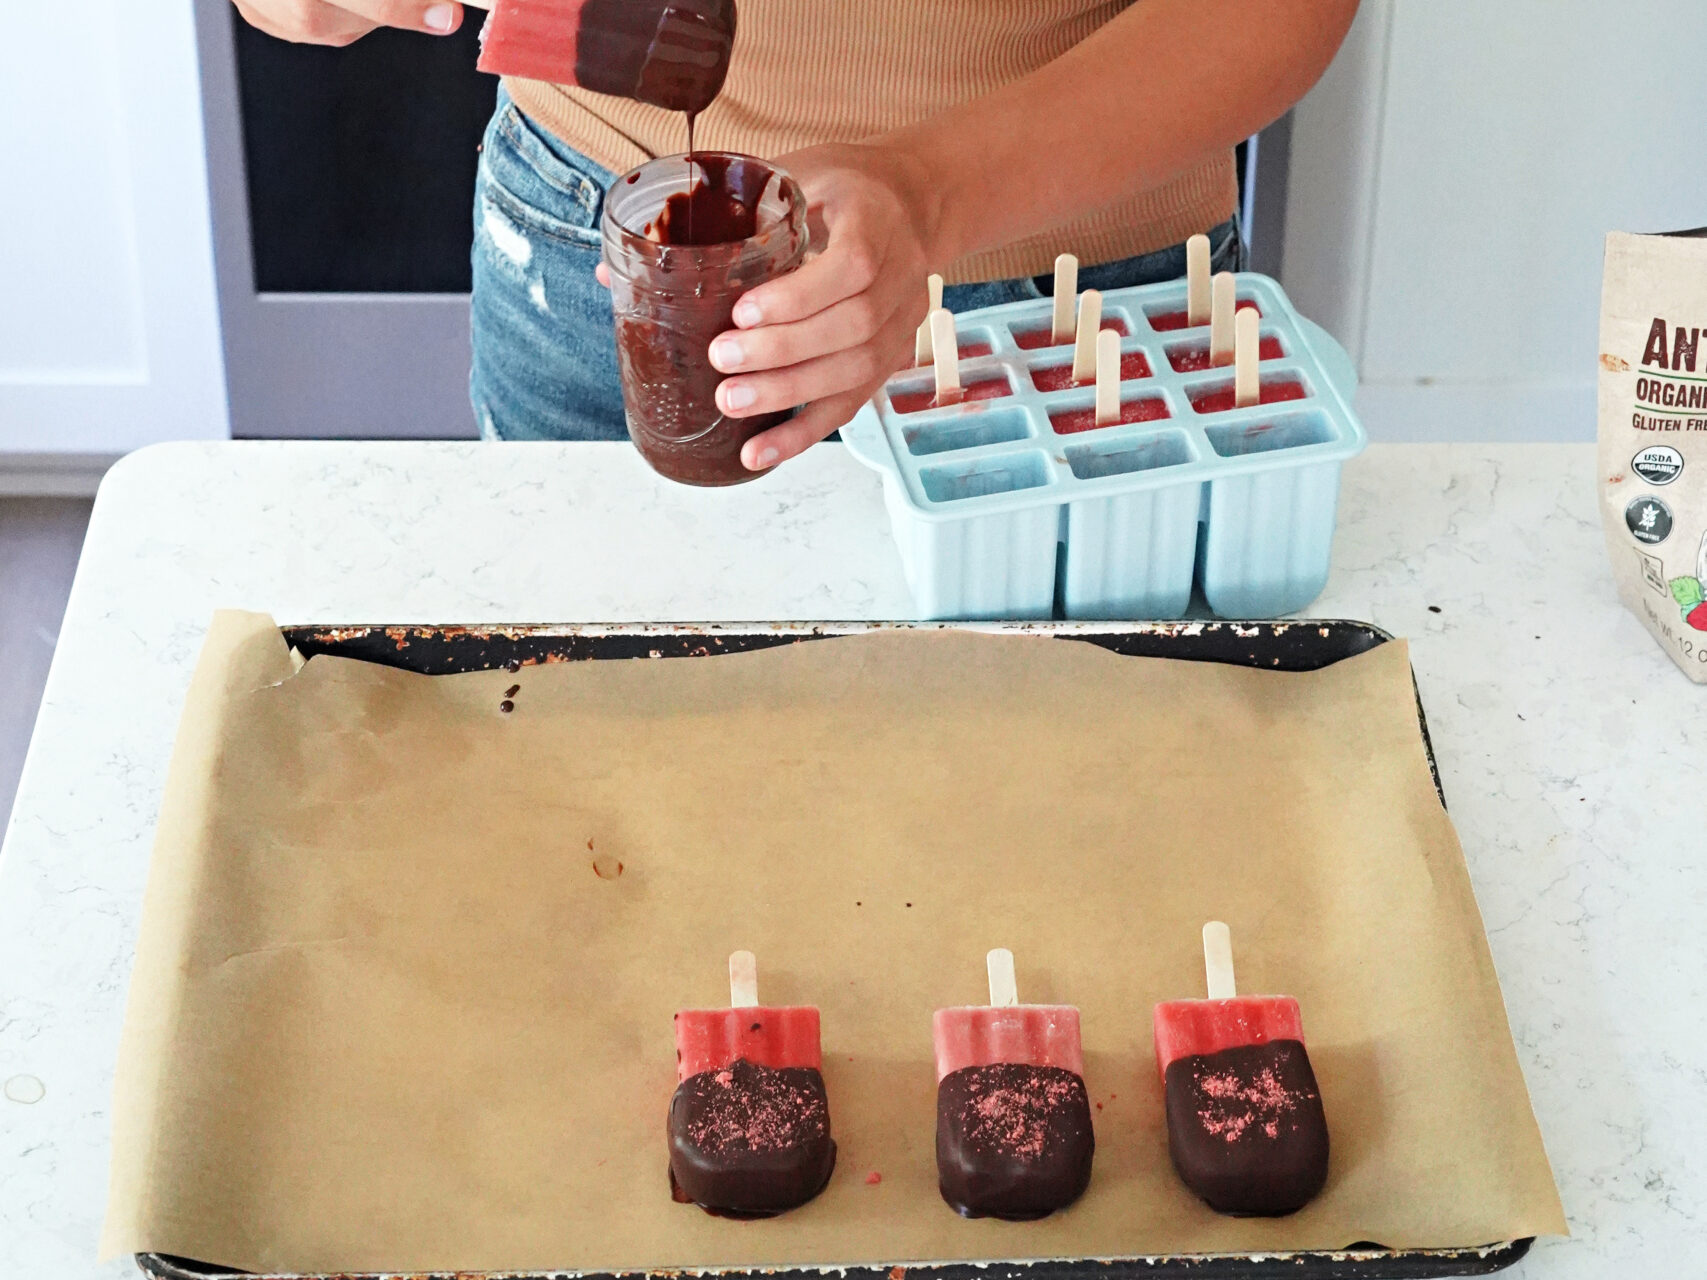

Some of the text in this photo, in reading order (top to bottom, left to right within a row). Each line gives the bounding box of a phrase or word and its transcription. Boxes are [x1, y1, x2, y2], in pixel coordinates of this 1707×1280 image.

[1642, 317, 1707, 373] AN
[1632, 413, 1681, 432] GLUTEN
[1644, 454, 1673, 463] USDA
[1638, 463, 1676, 475] ORGANIC
[1678, 637, 1693, 659] 12
